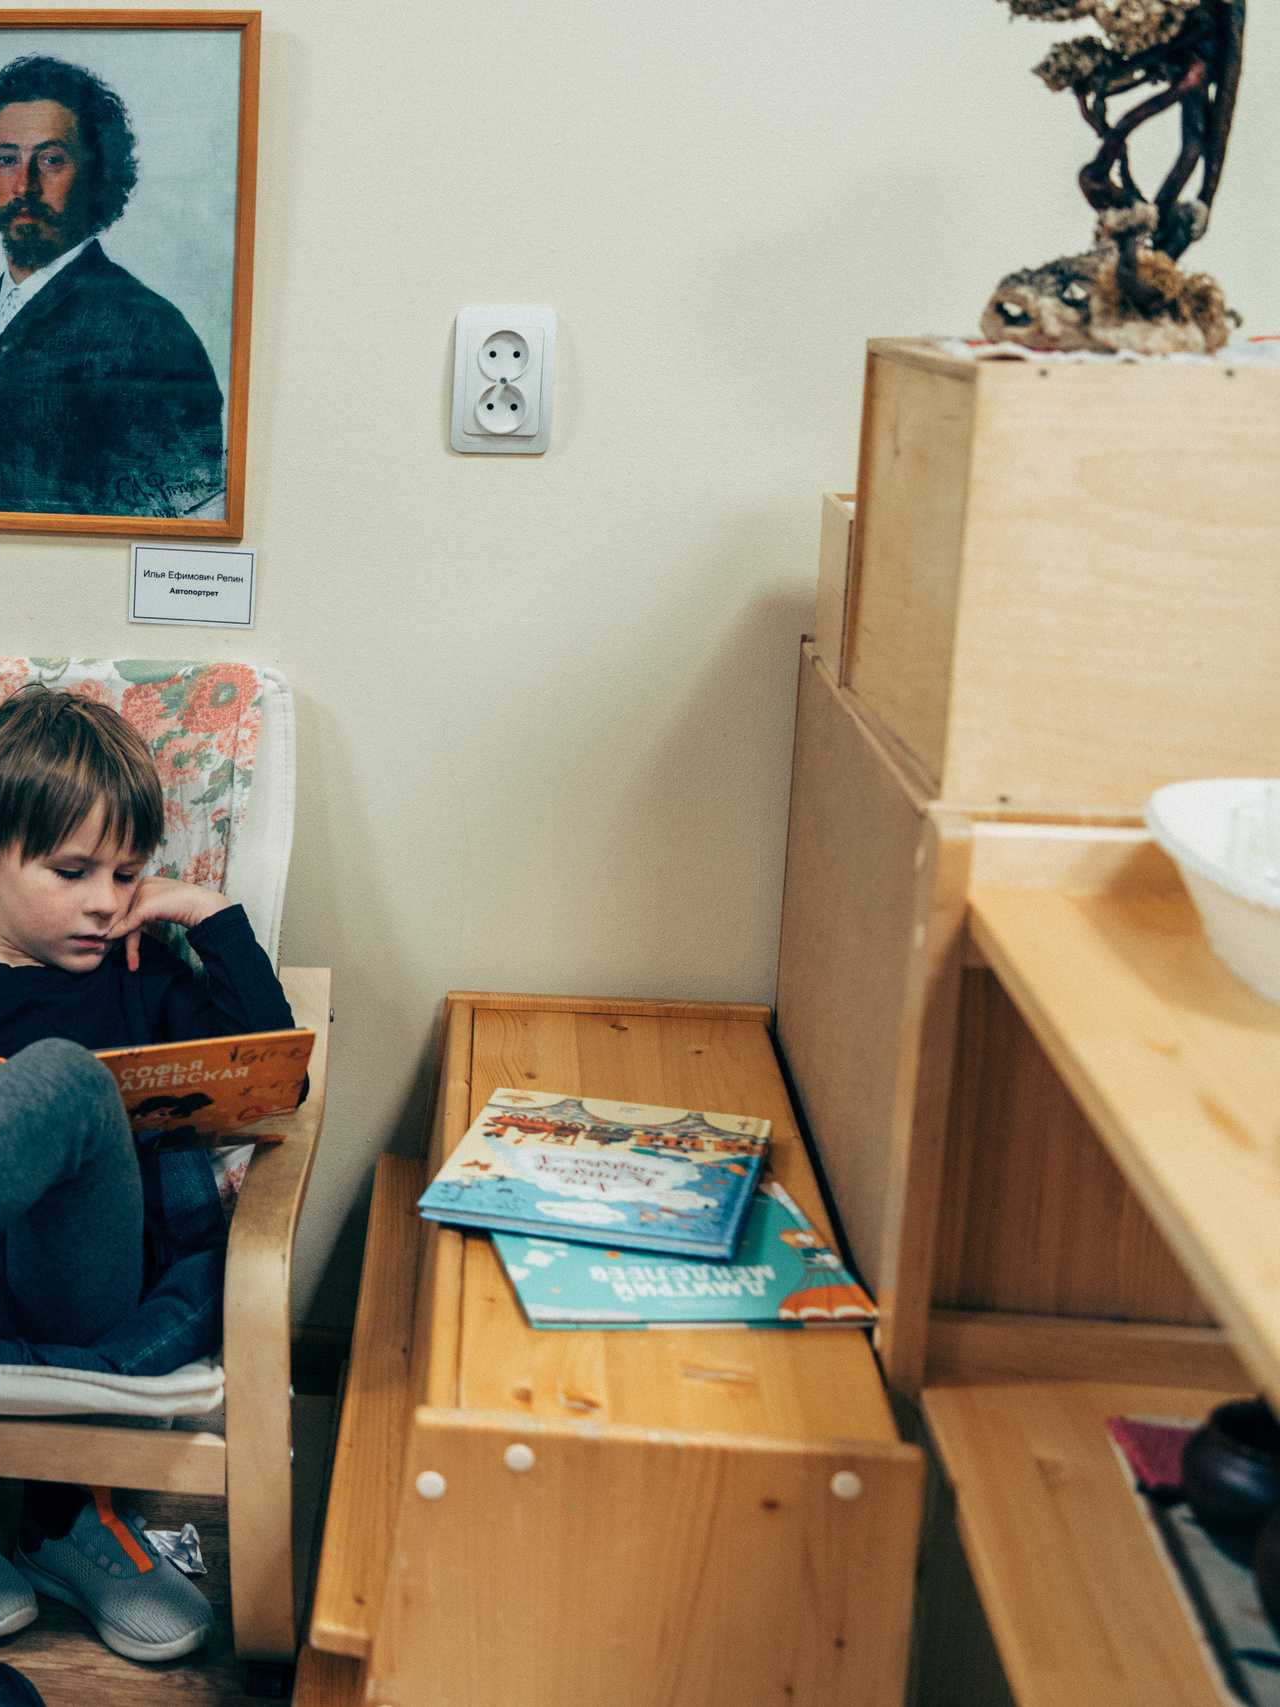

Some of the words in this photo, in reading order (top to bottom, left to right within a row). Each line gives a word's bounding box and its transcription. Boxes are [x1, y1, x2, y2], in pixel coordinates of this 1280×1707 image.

[143, 569, 166, 579] Илья
[168, 570, 215, 582] Ефимович
[216, 573, 244, 583] Репин
[169, 587, 219, 597] Автопортрет
[120, 1059, 204, 1081] СОФЬЯ
[121, 1066, 250, 1091] АЛЕВСКАЯ
[588, 1265, 776, 1282] МЕНДЕЛЕЕВ
[609, 1277, 766, 1303] ДМИТРИЙ
